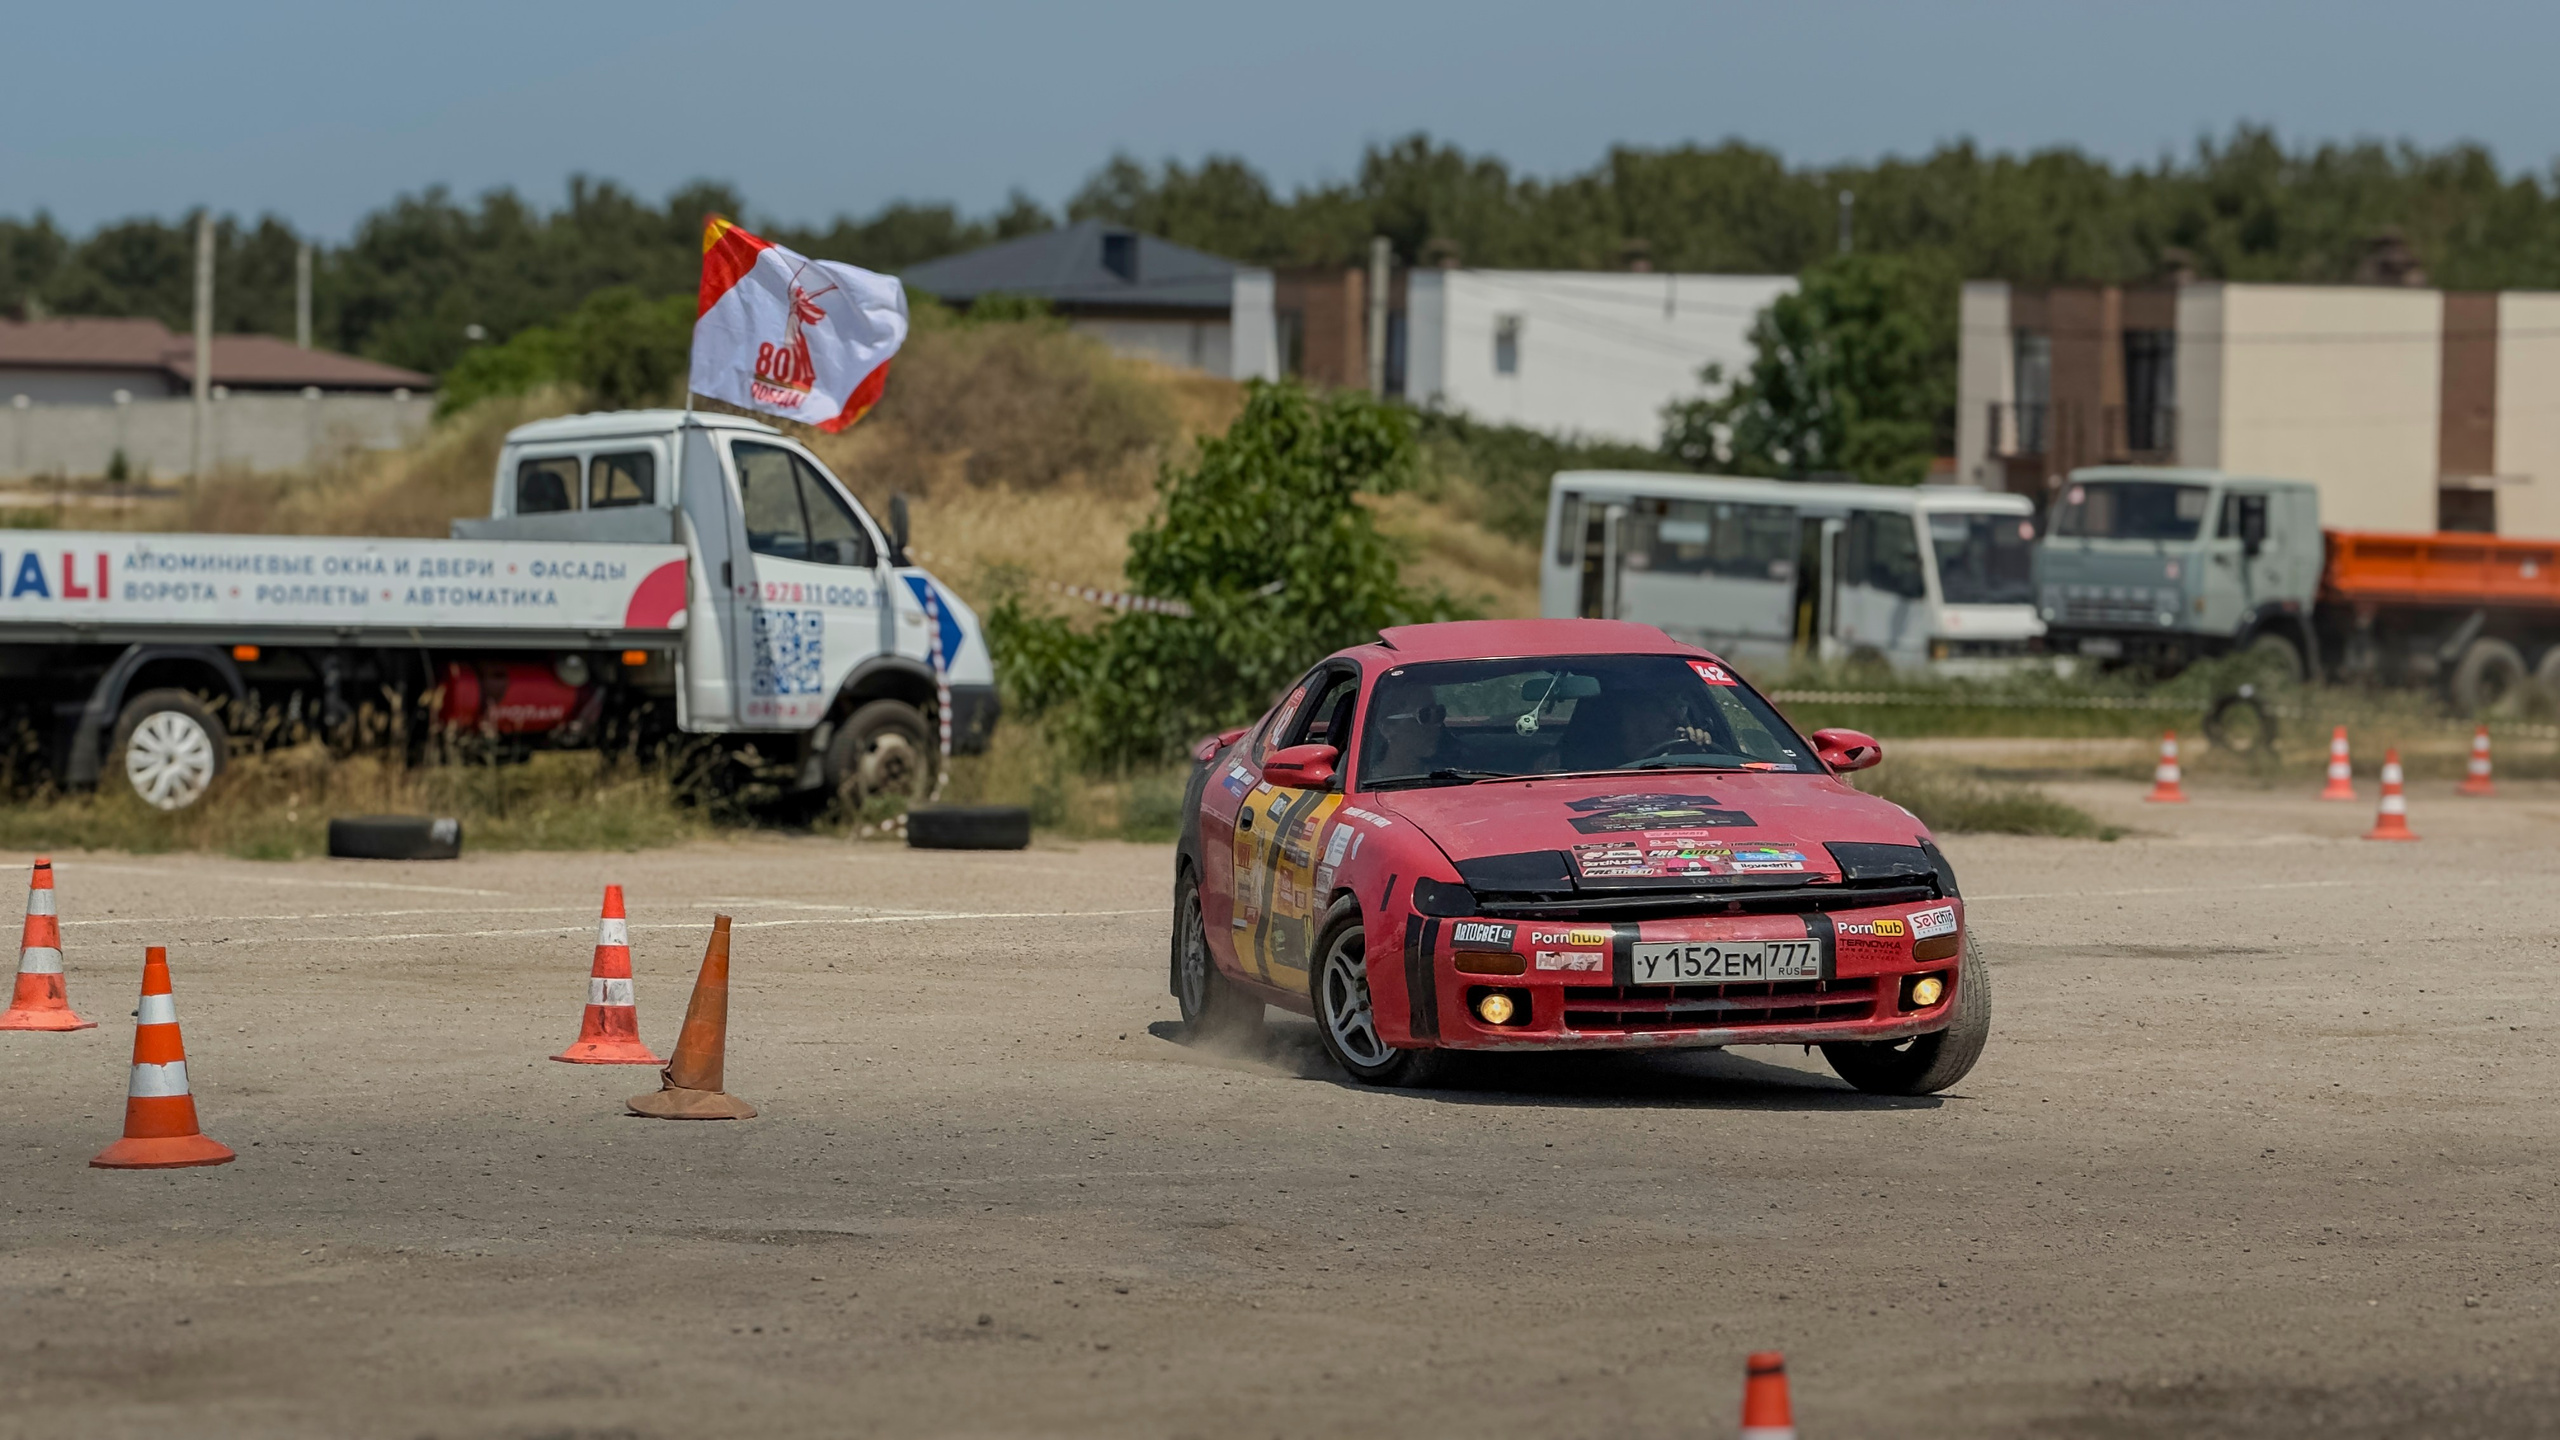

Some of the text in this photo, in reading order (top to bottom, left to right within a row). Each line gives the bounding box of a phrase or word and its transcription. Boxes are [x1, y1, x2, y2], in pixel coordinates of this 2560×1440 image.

[756, 342, 789, 382] 80
[0, 552, 110, 600] ALI
[322, 557, 387, 576] ОКНА
[393, 558, 410, 574] И
[416, 558, 494, 579] ДВЕРИ
[529, 561, 626, 580] ФАСАДЫ
[124, 583, 558, 607] ВОРОТА РОЛЛЕТЫ АВТОМАТИКА
[1695, 665, 1733, 681] 42
[1690, 876, 1738, 884] TOYOT
[1838, 920, 1902, 935] Pornhub
[1531, 930, 1603, 946] Pornhub
[1839, 938, 1902, 949] TERNOVKA
[1767, 943, 1811, 967] 777
[1778, 967, 1800, 976] RUS
